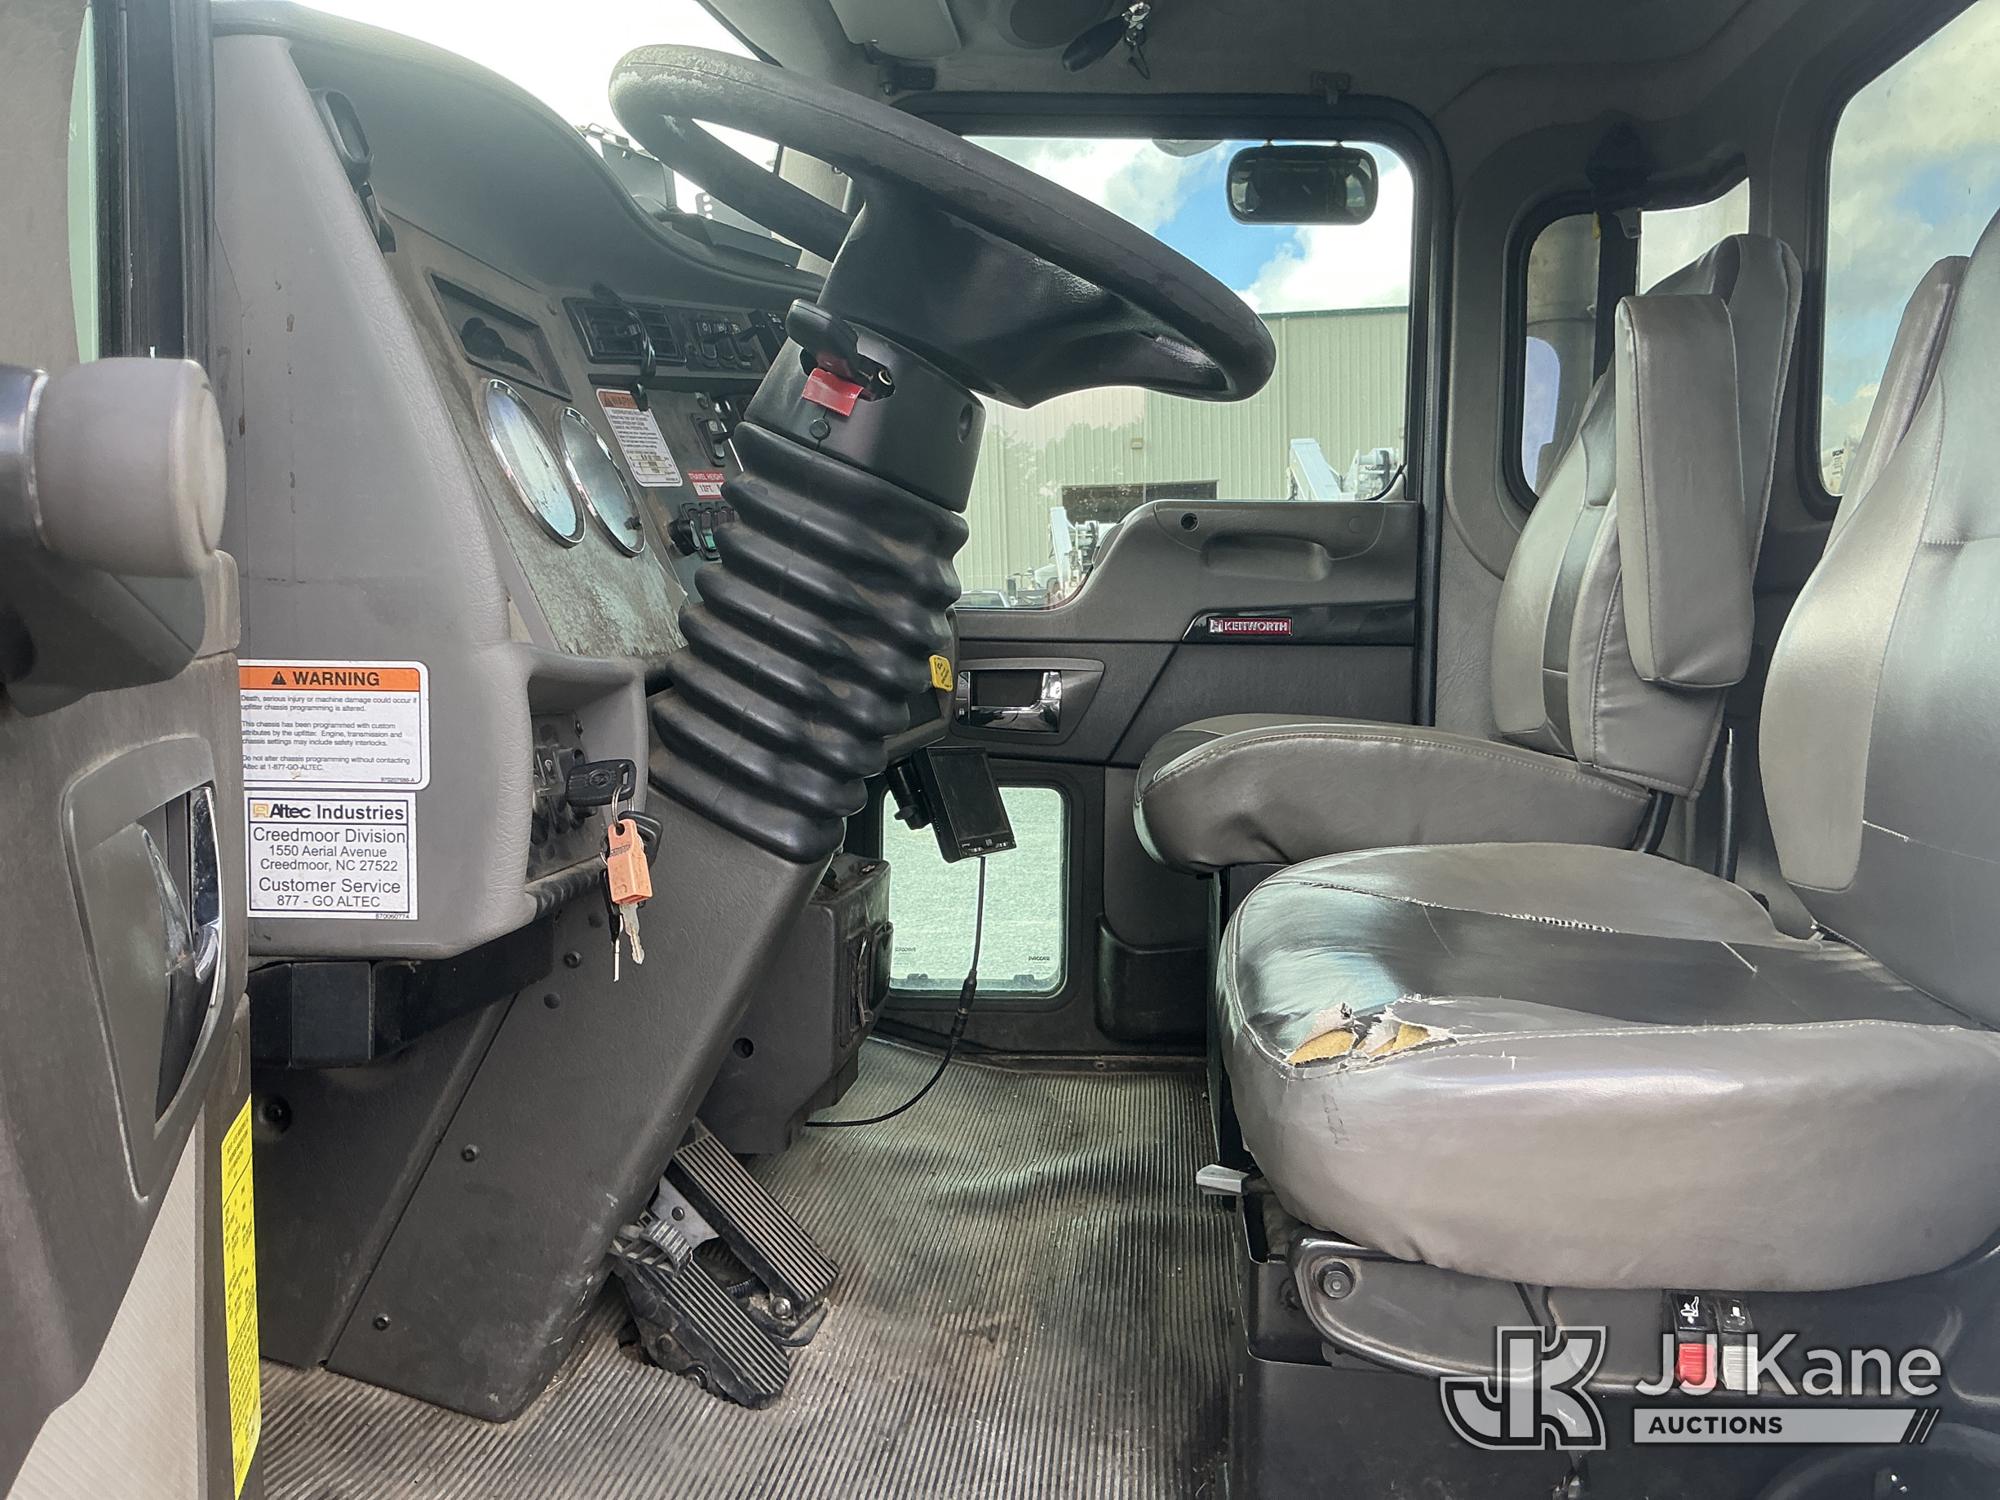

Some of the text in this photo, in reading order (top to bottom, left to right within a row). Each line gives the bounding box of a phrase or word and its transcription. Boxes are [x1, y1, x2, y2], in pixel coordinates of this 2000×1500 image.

[1224, 621, 1289, 632] KENWORTH
[292, 671, 380, 686] WARNING
[321, 730, 346, 738] Engine,
[269, 803, 404, 820] Altec Industries
[253, 827, 406, 844] Creedmoor Division
[269, 845, 387, 858] 1550 Aerial Avenue
[260, 858, 398, 872] Creedmoor, NC 27522
[259, 877, 401, 894] Customer Service
[277, 895, 300, 906] 877
[312, 895, 334, 907] GO
[337, 896, 380, 907] ALTEC
